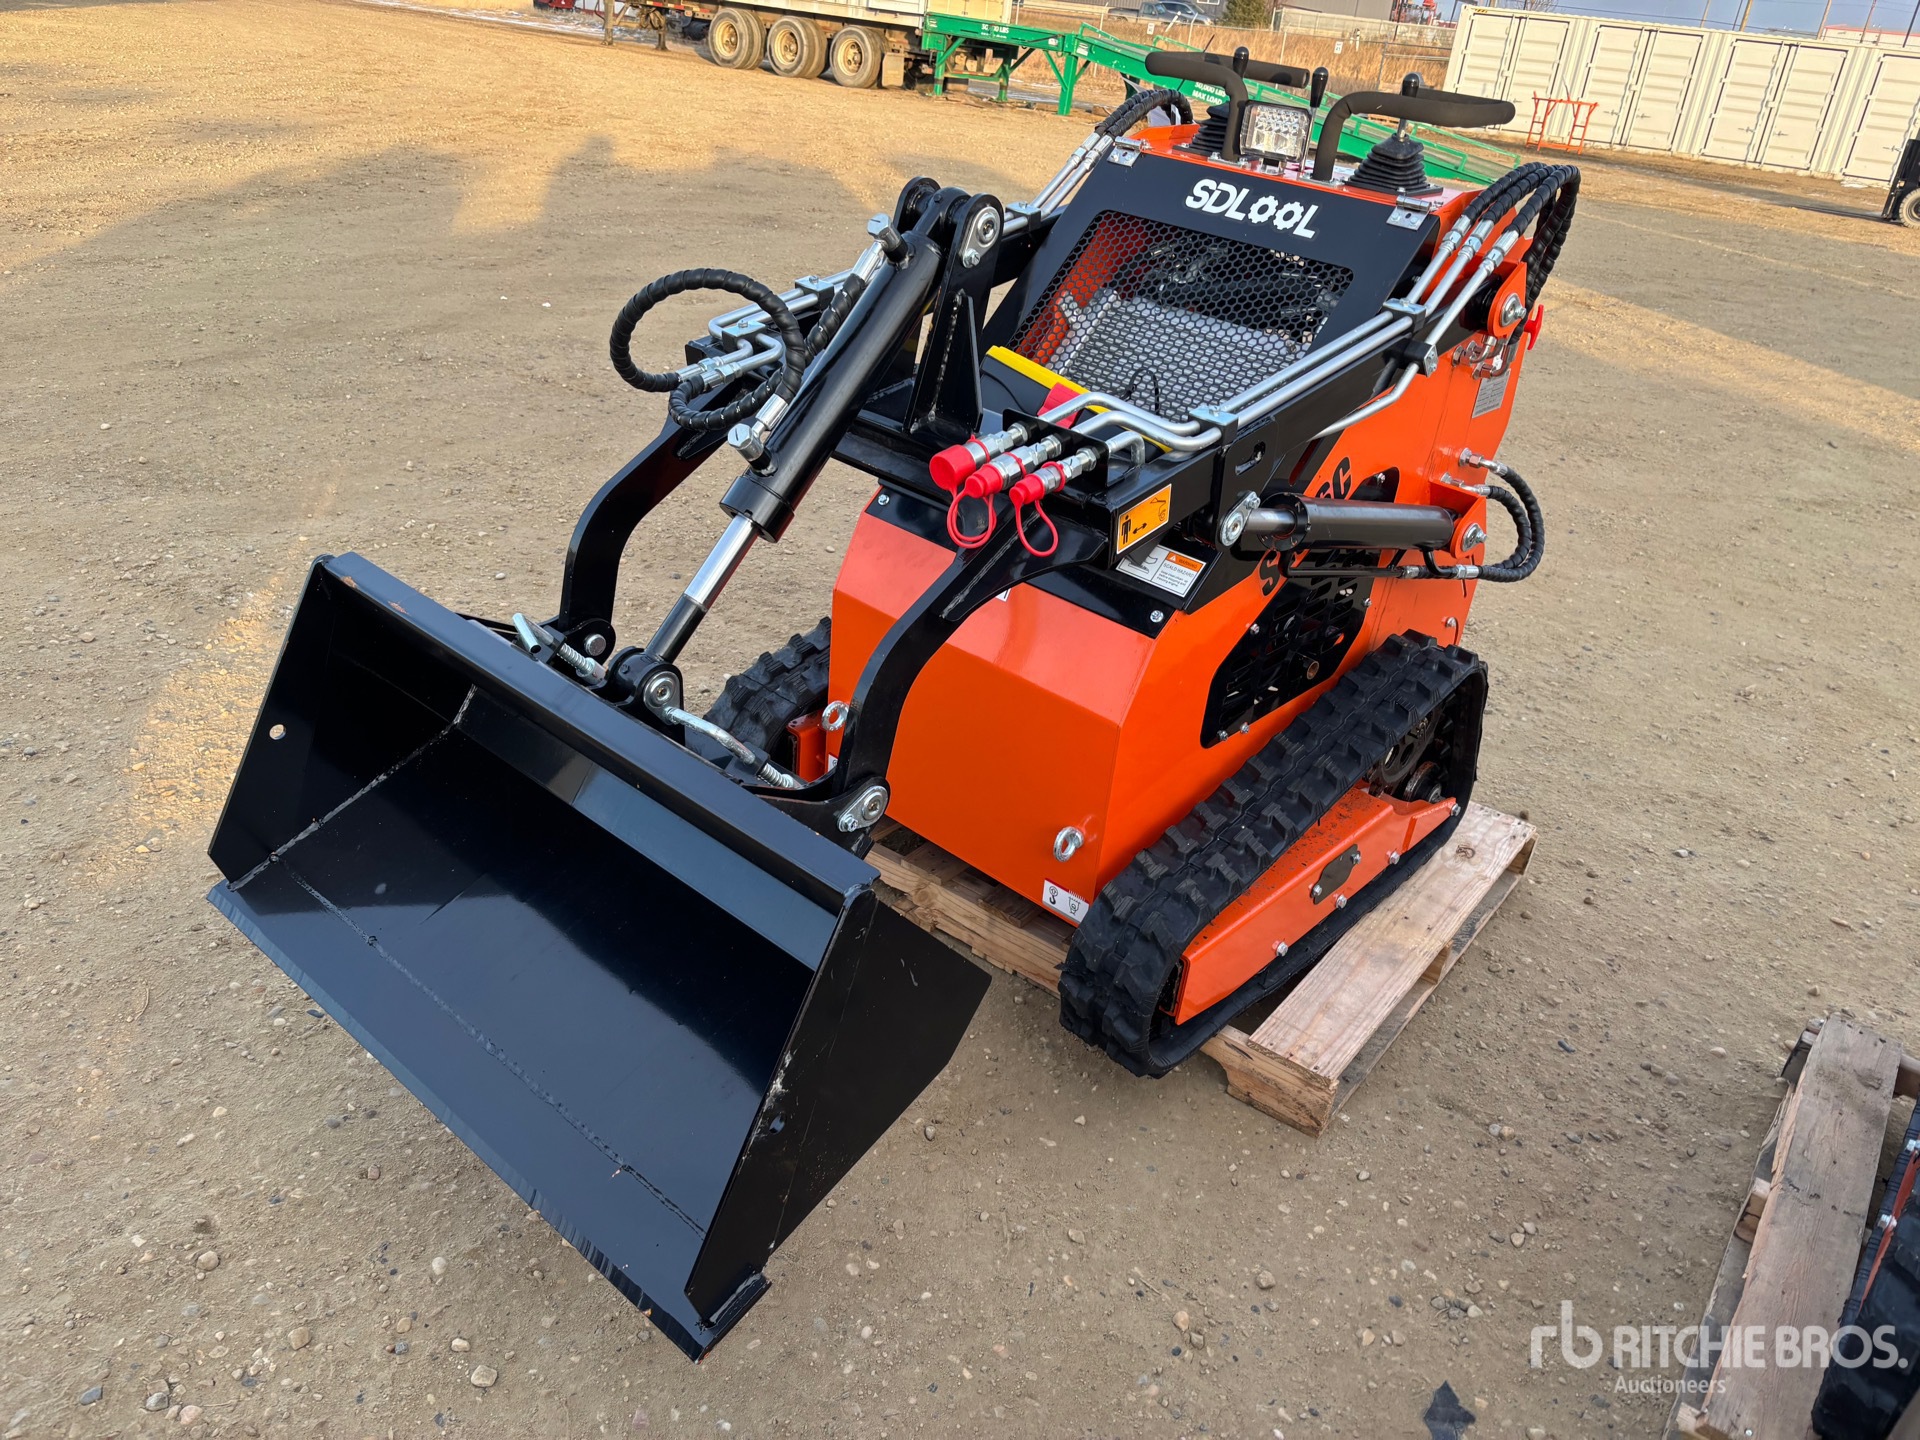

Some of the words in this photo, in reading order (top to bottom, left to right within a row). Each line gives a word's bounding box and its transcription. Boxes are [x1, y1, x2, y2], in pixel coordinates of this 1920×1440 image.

[1192, 90, 1206, 101] MAX
[1206, 94, 1223, 105] LOAD
[1178, 558, 1198, 569] WARNING
